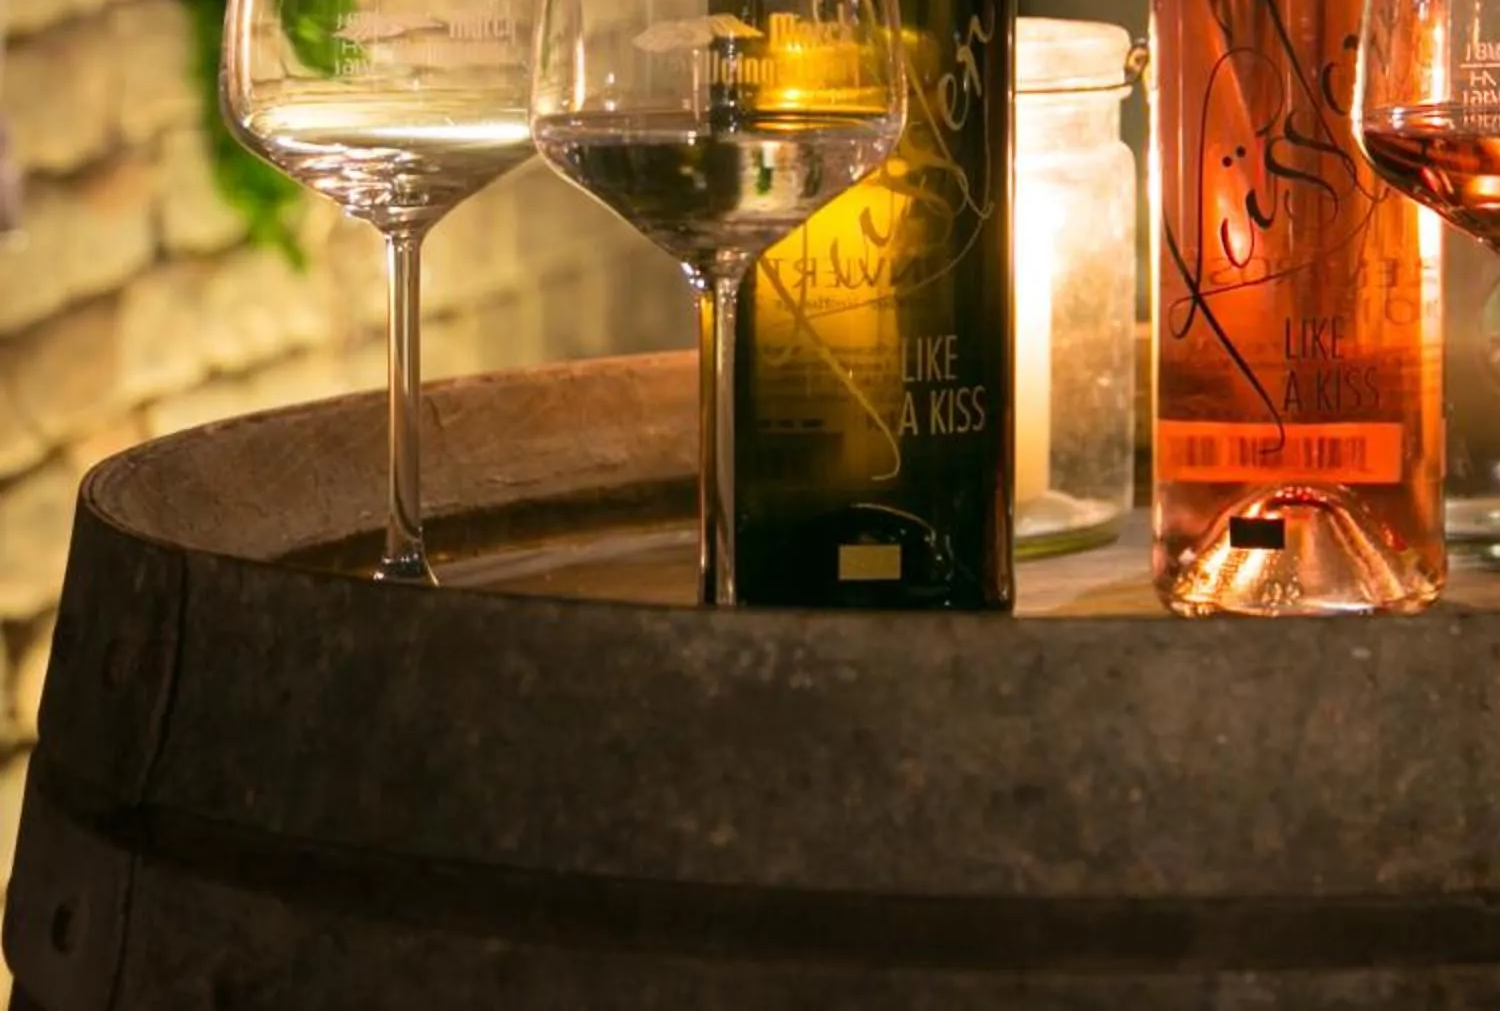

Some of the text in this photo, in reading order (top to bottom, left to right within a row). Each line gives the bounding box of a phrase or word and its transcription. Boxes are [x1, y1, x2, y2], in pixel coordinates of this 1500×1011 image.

[901, 335, 958, 383] LIKE
[1284, 317, 1345, 362] LIKE
[898, 385, 987, 436] A KISS
[1284, 366, 1380, 412] A KISS
